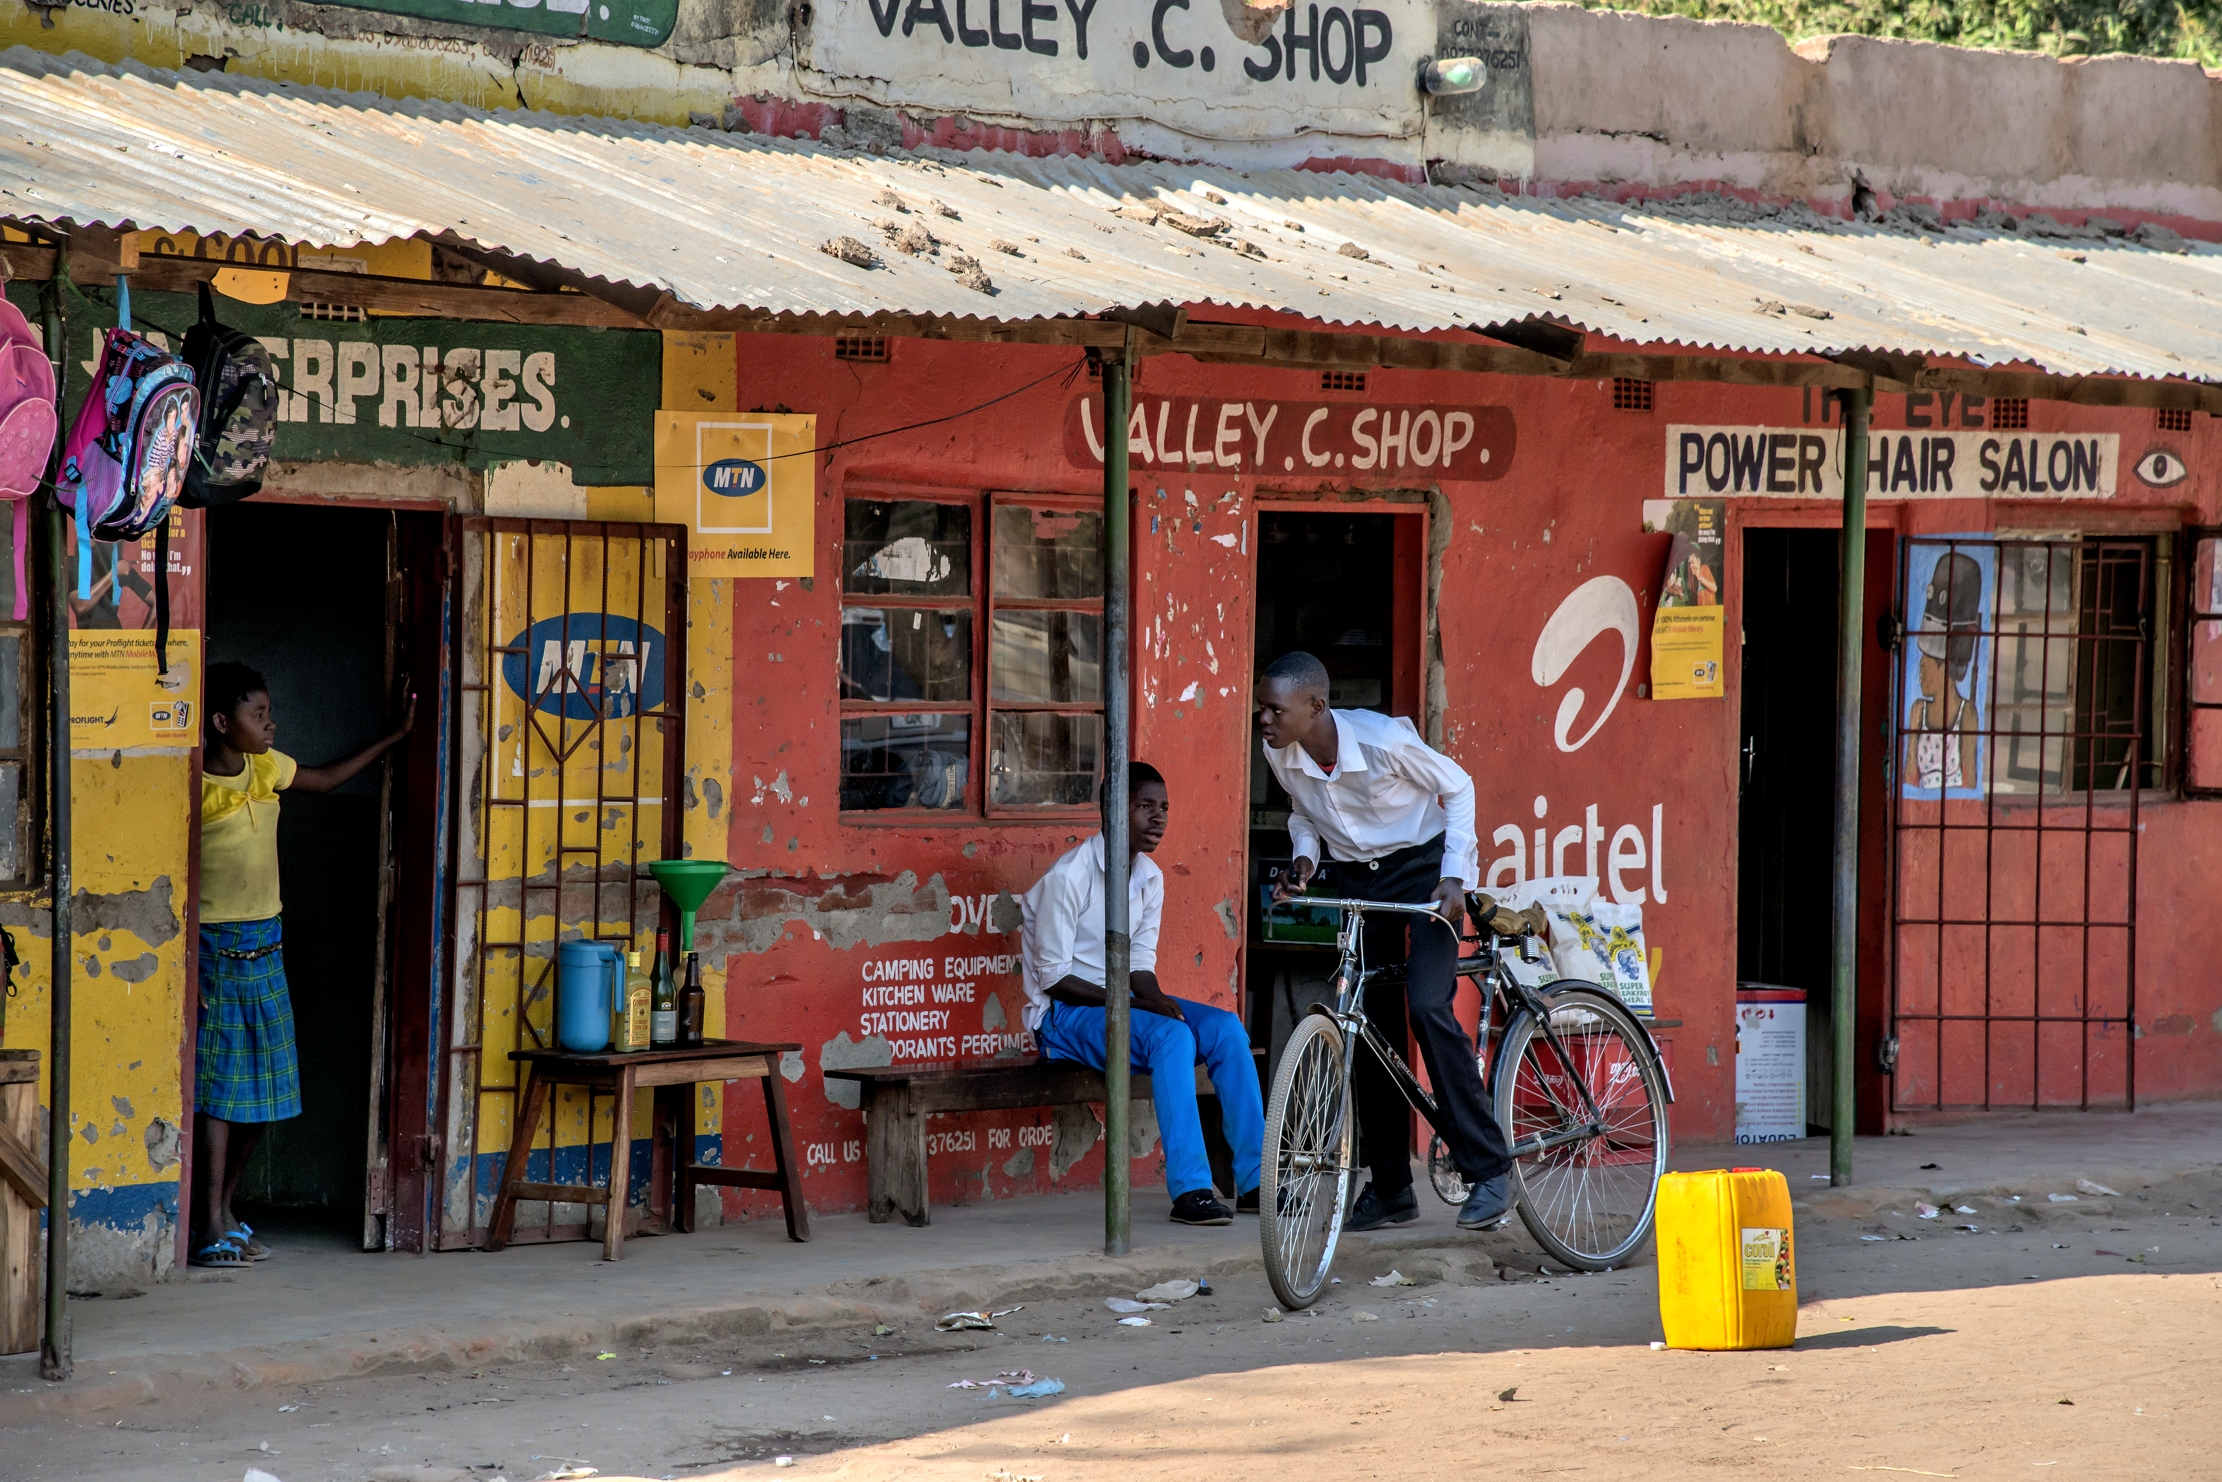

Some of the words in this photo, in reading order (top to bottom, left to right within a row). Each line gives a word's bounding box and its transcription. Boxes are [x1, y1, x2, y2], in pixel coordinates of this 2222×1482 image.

[1905, 390, 1986, 429] EYE
[1080, 396, 1279, 468] VALLEY
[1678, 432, 1827, 495] POWER
[1866, 435, 1956, 493] HAIR
[1978, 437, 2099, 493] SALON
[713, 466, 756, 489] MTN
[141, 550, 152, 561] No
[688, 548, 727, 562] ayphone
[726, 547, 768, 561] Available
[768, 547, 792, 560] Here.
[69, 650, 94, 660] nytime
[94, 650, 110, 659] with
[110, 650, 126, 659] MTN
[126, 650, 149, 658] Mobile
[78, 639, 89, 648] for
[89, 641, 105, 650] your
[105, 638, 135, 649] Proflight
[135, 638, 155, 648] tickets
[536, 639, 651, 694] MTN
[1485, 794, 1668, 905] airtel
[861, 957, 935, 982] CAMPING
[862, 984, 925, 1008] KITCHEN
[931, 982, 976, 1004] WARE
[1619, 982, 1645, 990] SUPER
[860, 1009, 951, 1036] STATIONERY
[806, 1142, 838, 1166] CALL
[843, 1139, 861, 1163] US
[926, 1130, 976, 1156] 376251
[987, 1127, 1012, 1150] FOR
[1018, 1124, 1053, 1148] ORDE
